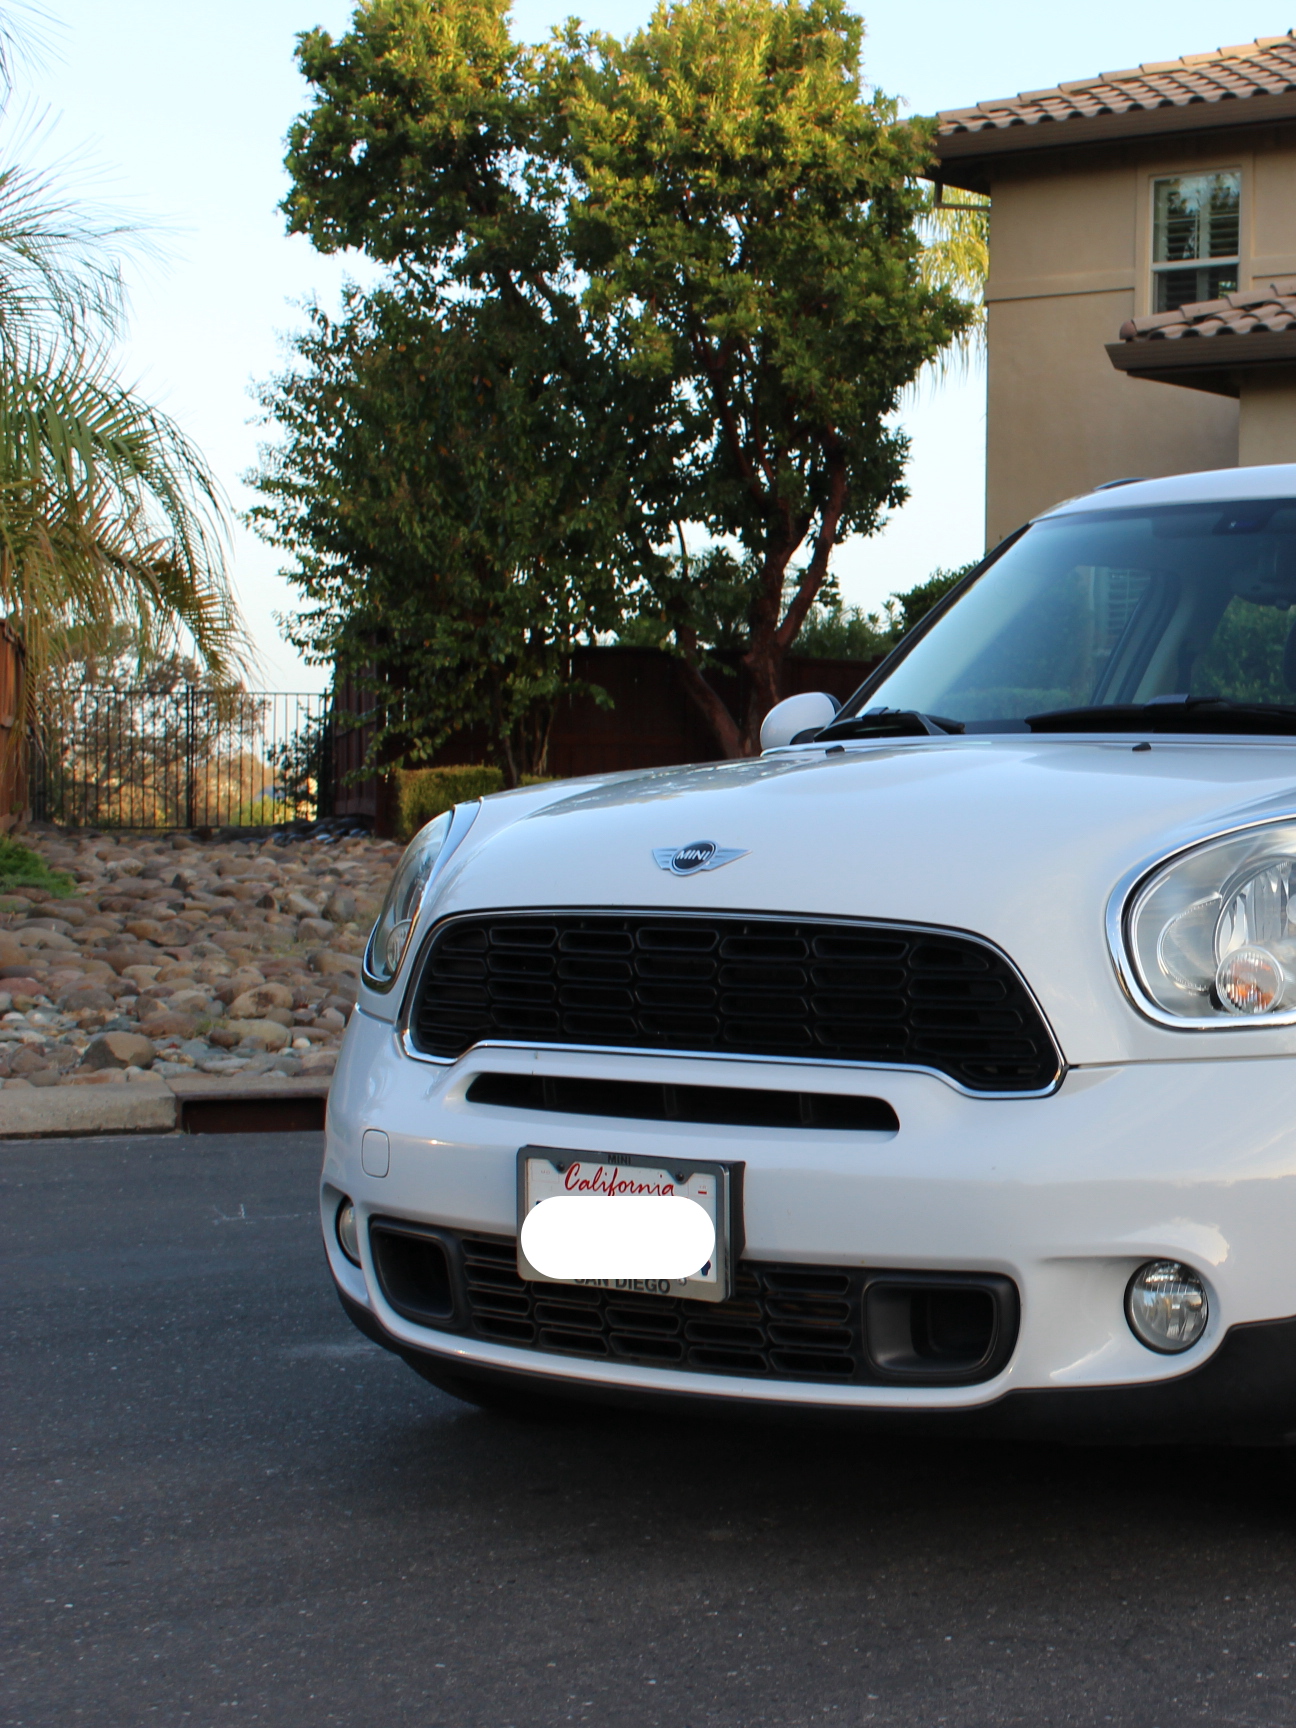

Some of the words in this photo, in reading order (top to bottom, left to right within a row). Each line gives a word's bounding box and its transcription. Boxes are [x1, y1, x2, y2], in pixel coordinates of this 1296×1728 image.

[676, 849, 711, 861] MINI
[607, 1154, 632, 1166] MINI
[564, 1163, 675, 1196] California
[615, 1279, 671, 1294] DIEGO
